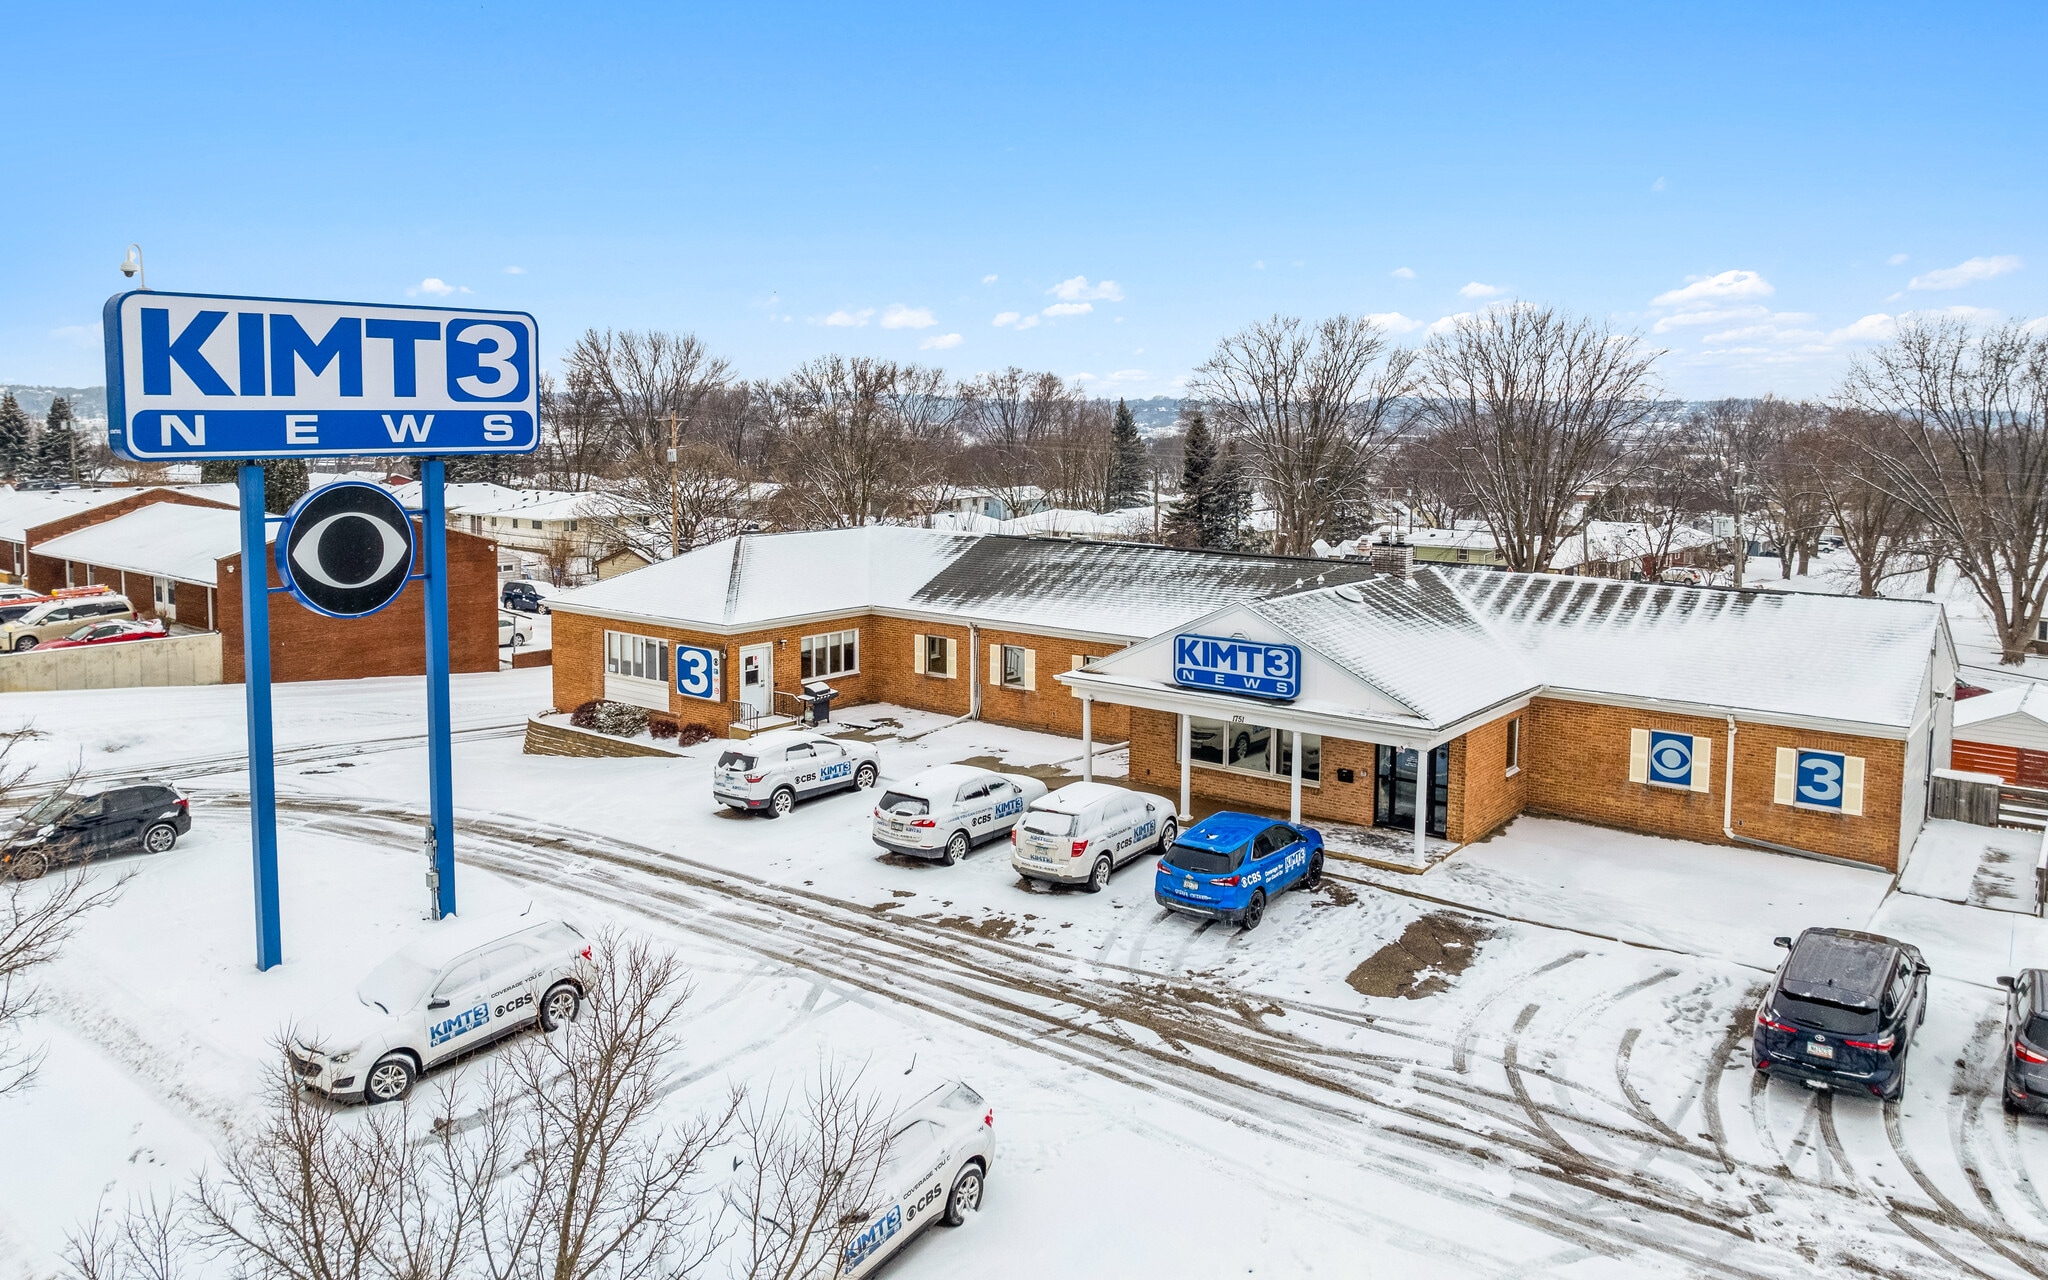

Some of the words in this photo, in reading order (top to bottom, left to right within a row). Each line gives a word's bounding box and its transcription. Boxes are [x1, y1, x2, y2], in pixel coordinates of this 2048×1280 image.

[160, 414, 515, 447] NEWS
[681, 650, 708, 694] 3
[1182, 669, 1288, 693] NEWS
[1232, 715, 1245, 723] 1751
[801, 772, 817, 783] CBS
[1798, 758, 1841, 800] 3
[977, 813, 992, 825] CBS
[1121, 836, 1133, 850] CBS
[1247, 871, 1262, 885] CBS
[490, 981, 524, 999] COVERAGE
[524, 974, 538, 984] YOU
[505, 992, 534, 1013] CBS
[902, 1170, 934, 1200] COVERAGE
[934, 1159, 946, 1172] YOU
[917, 1182, 942, 1213] CBS
